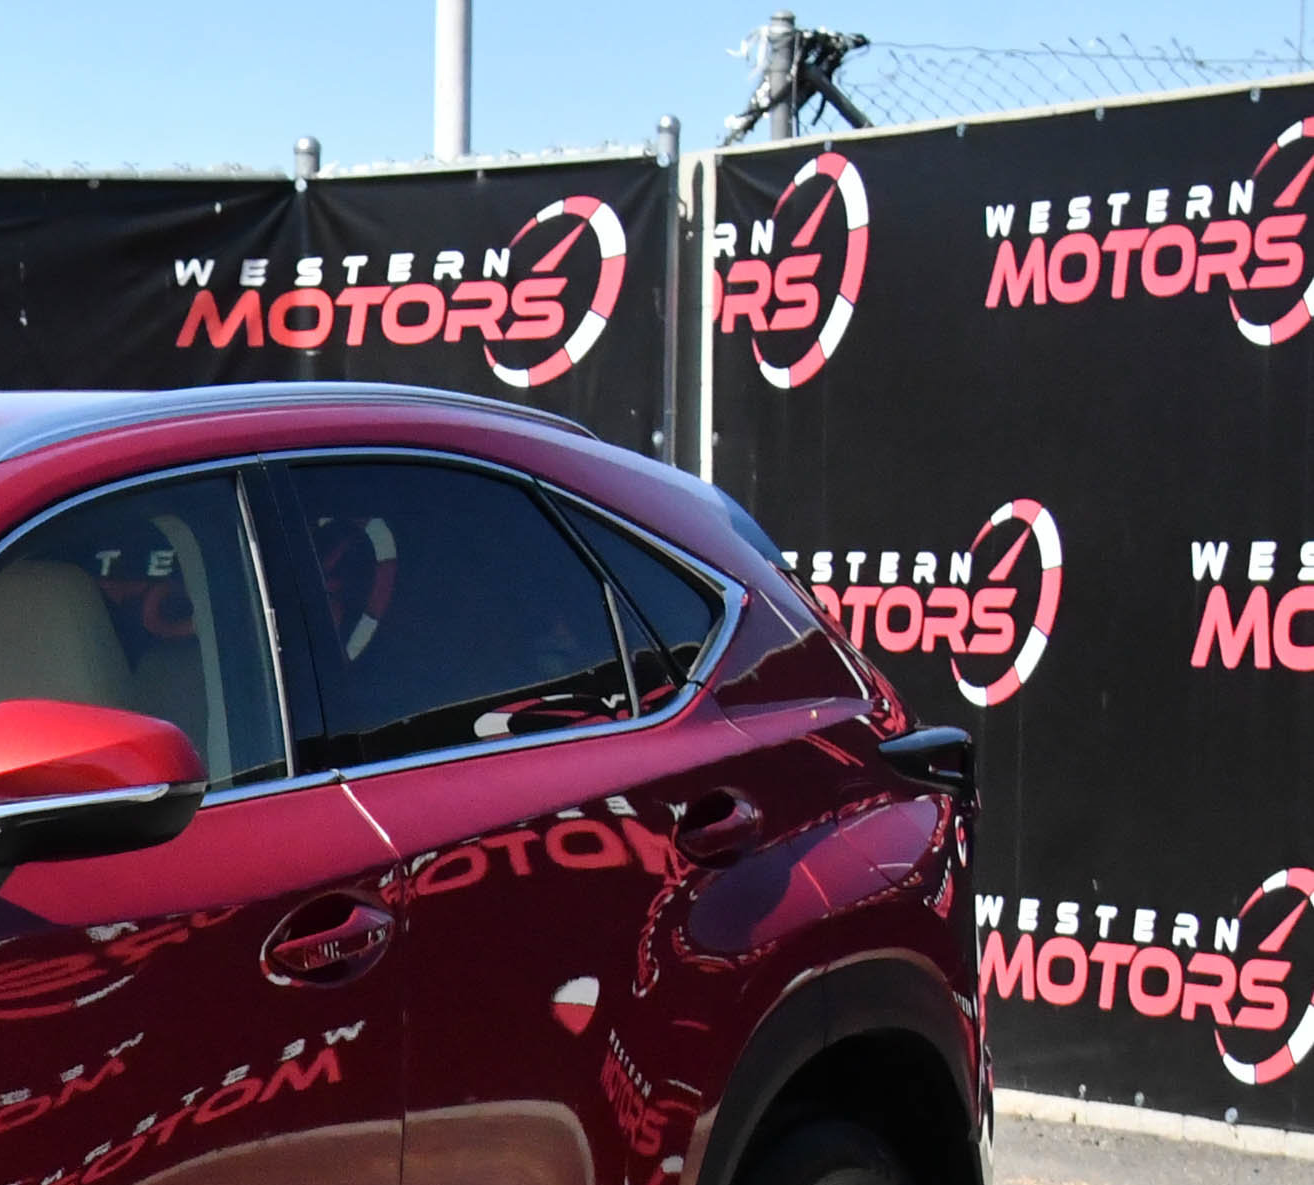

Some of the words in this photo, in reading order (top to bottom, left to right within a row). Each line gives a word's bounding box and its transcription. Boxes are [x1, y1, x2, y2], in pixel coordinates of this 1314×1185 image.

[985, 178, 1255, 239] WESTERN
[174, 247, 511, 287] WESTERN
[713, 252, 823, 334] RS
[984, 213, 1308, 309] MOTORS
[176, 276, 569, 350] MOTORS
[975, 893, 1240, 953] WESTERN
[977, 931, 1292, 1030] MOTORS
